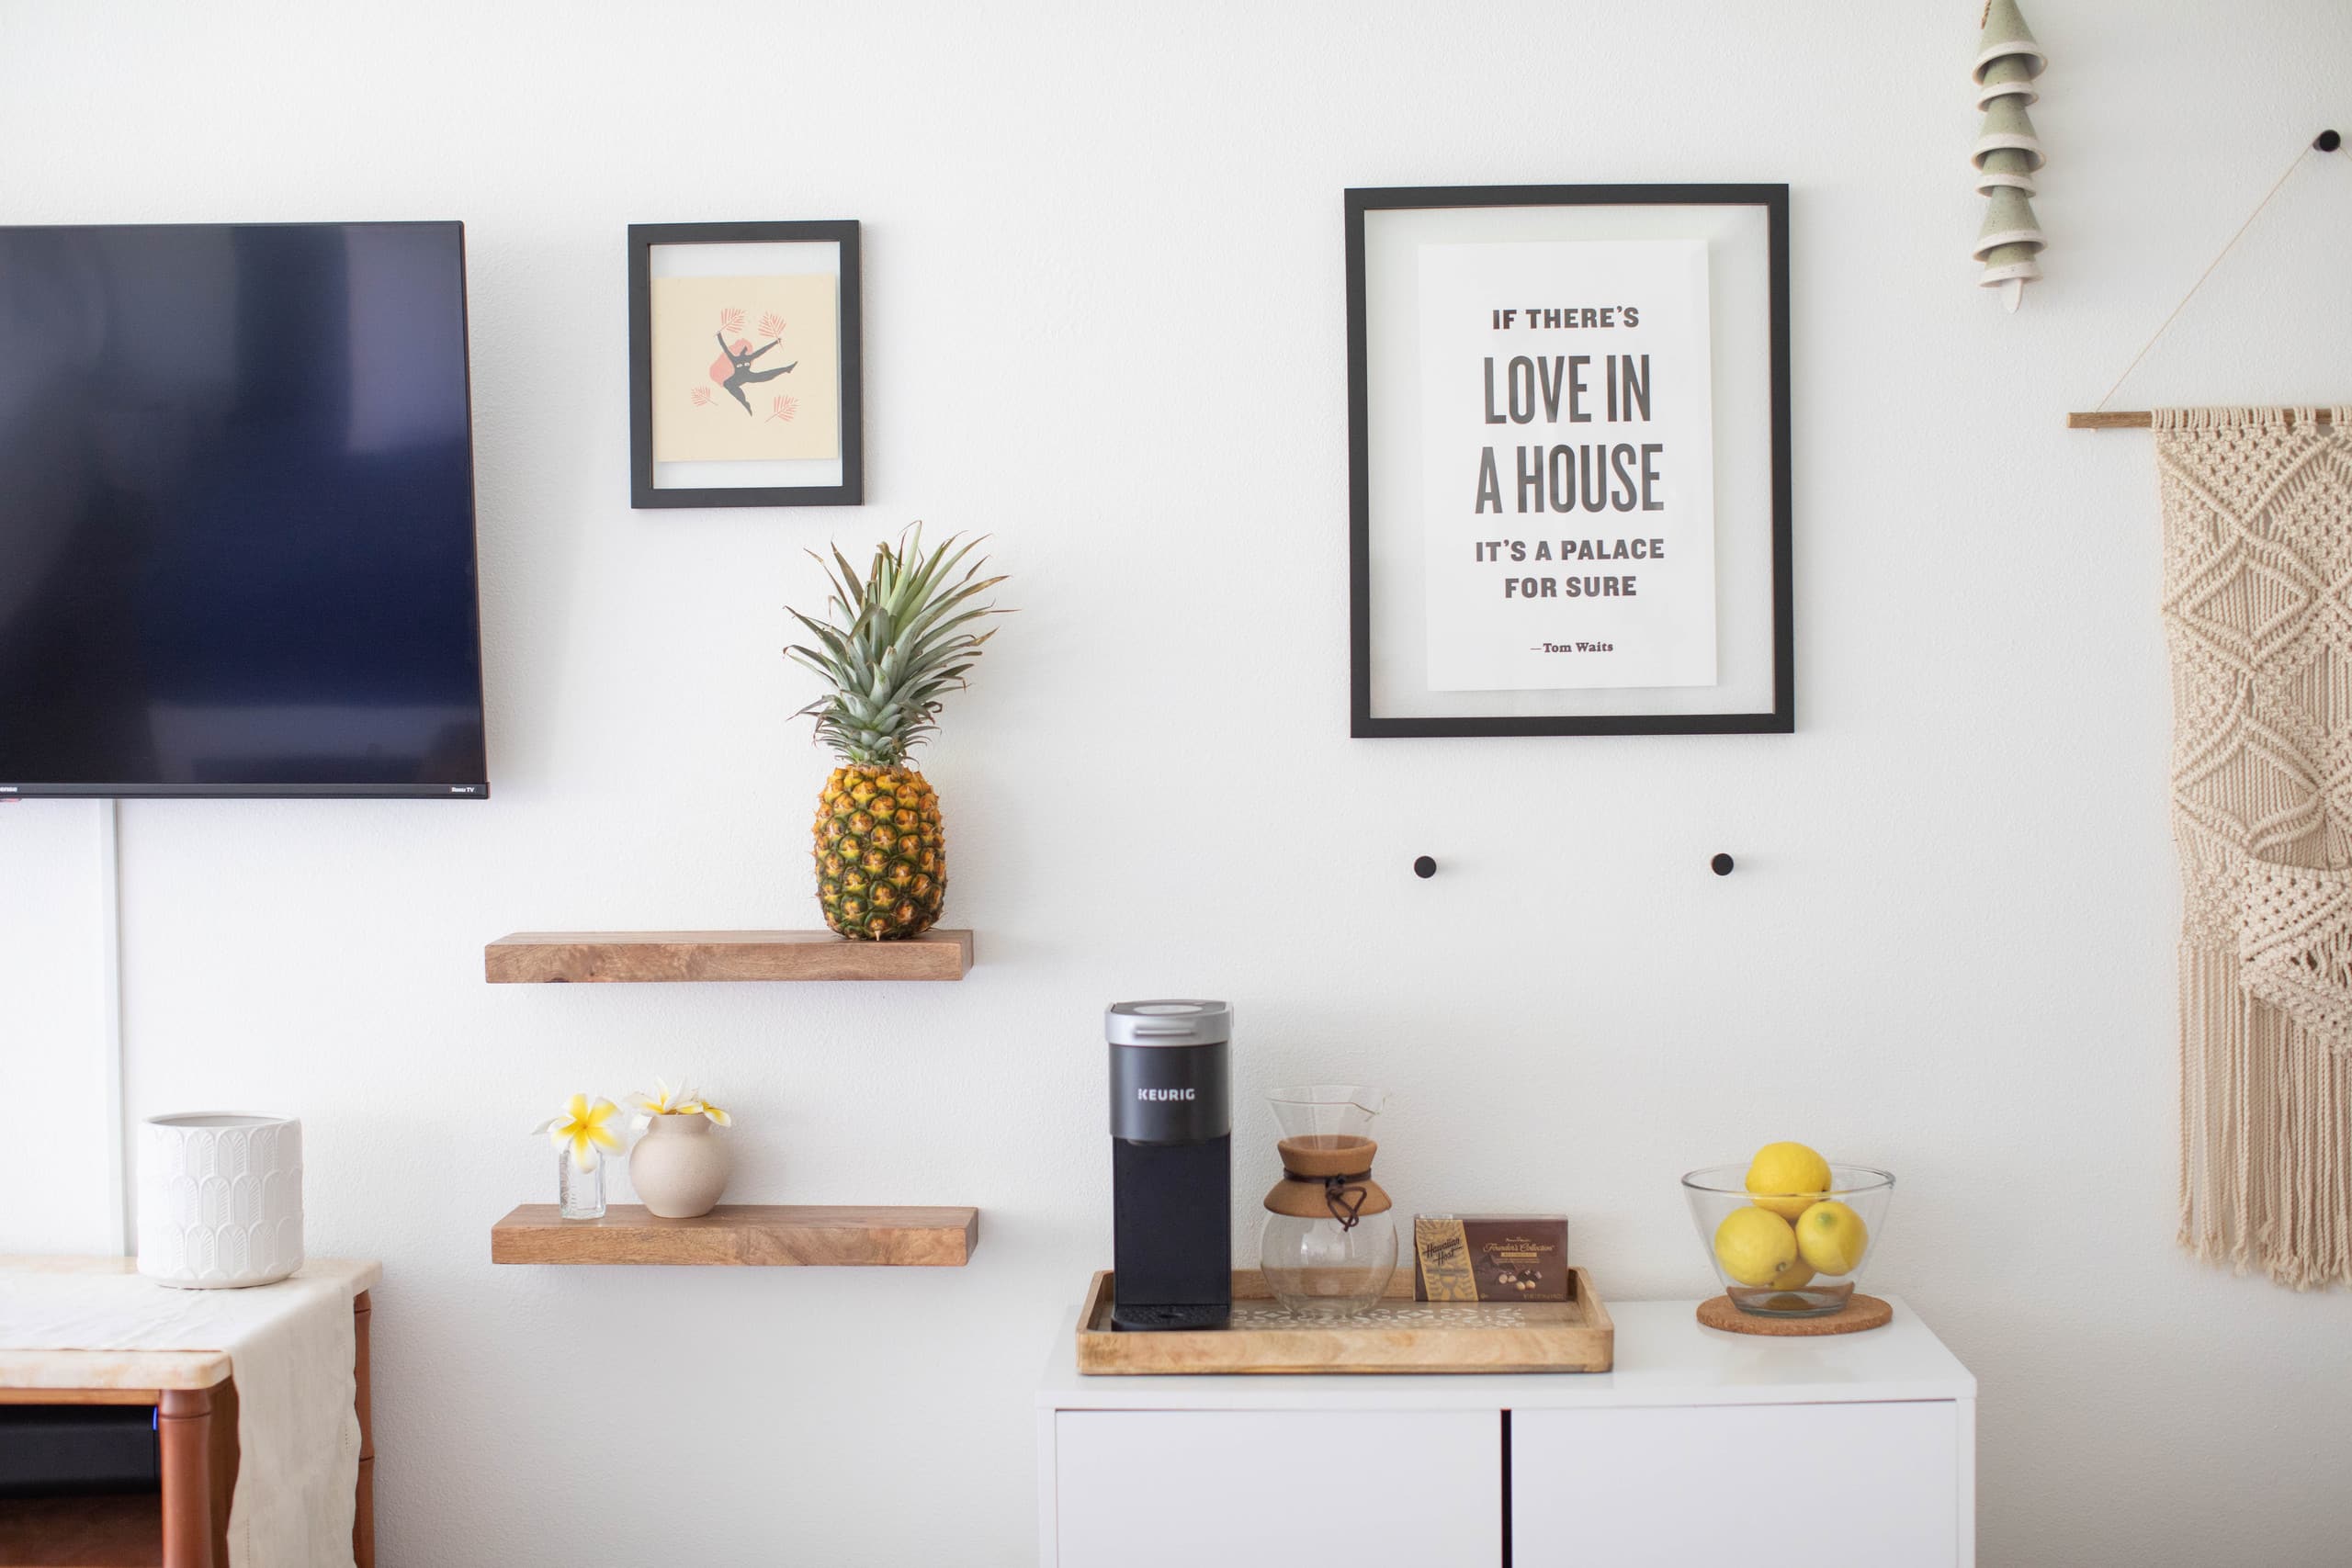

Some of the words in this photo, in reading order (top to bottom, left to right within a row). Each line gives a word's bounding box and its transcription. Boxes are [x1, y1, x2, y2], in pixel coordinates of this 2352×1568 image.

[1493, 309, 1518, 330] IF
[1525, 305, 1639, 330] THERE'S
[1484, 355, 1592, 425] LOVE
[1606, 354, 1651, 423] IN
[1475, 446, 1503, 514] A
[1517, 443, 1664, 513] HOUSE
[1476, 539, 1526, 562] IT'S
[1534, 540, 1553, 561] A
[1561, 538, 1665, 561] PALACE
[1505, 577, 1557, 599] FOR
[1566, 575, 1637, 598] SURE
[1575, 641, 1614, 653] Waits
[1137, 1088, 1196, 1101] KEURIG
[1422, 1237, 1461, 1258] Hawaiian
[1432, 1246, 1464, 1266] Host
